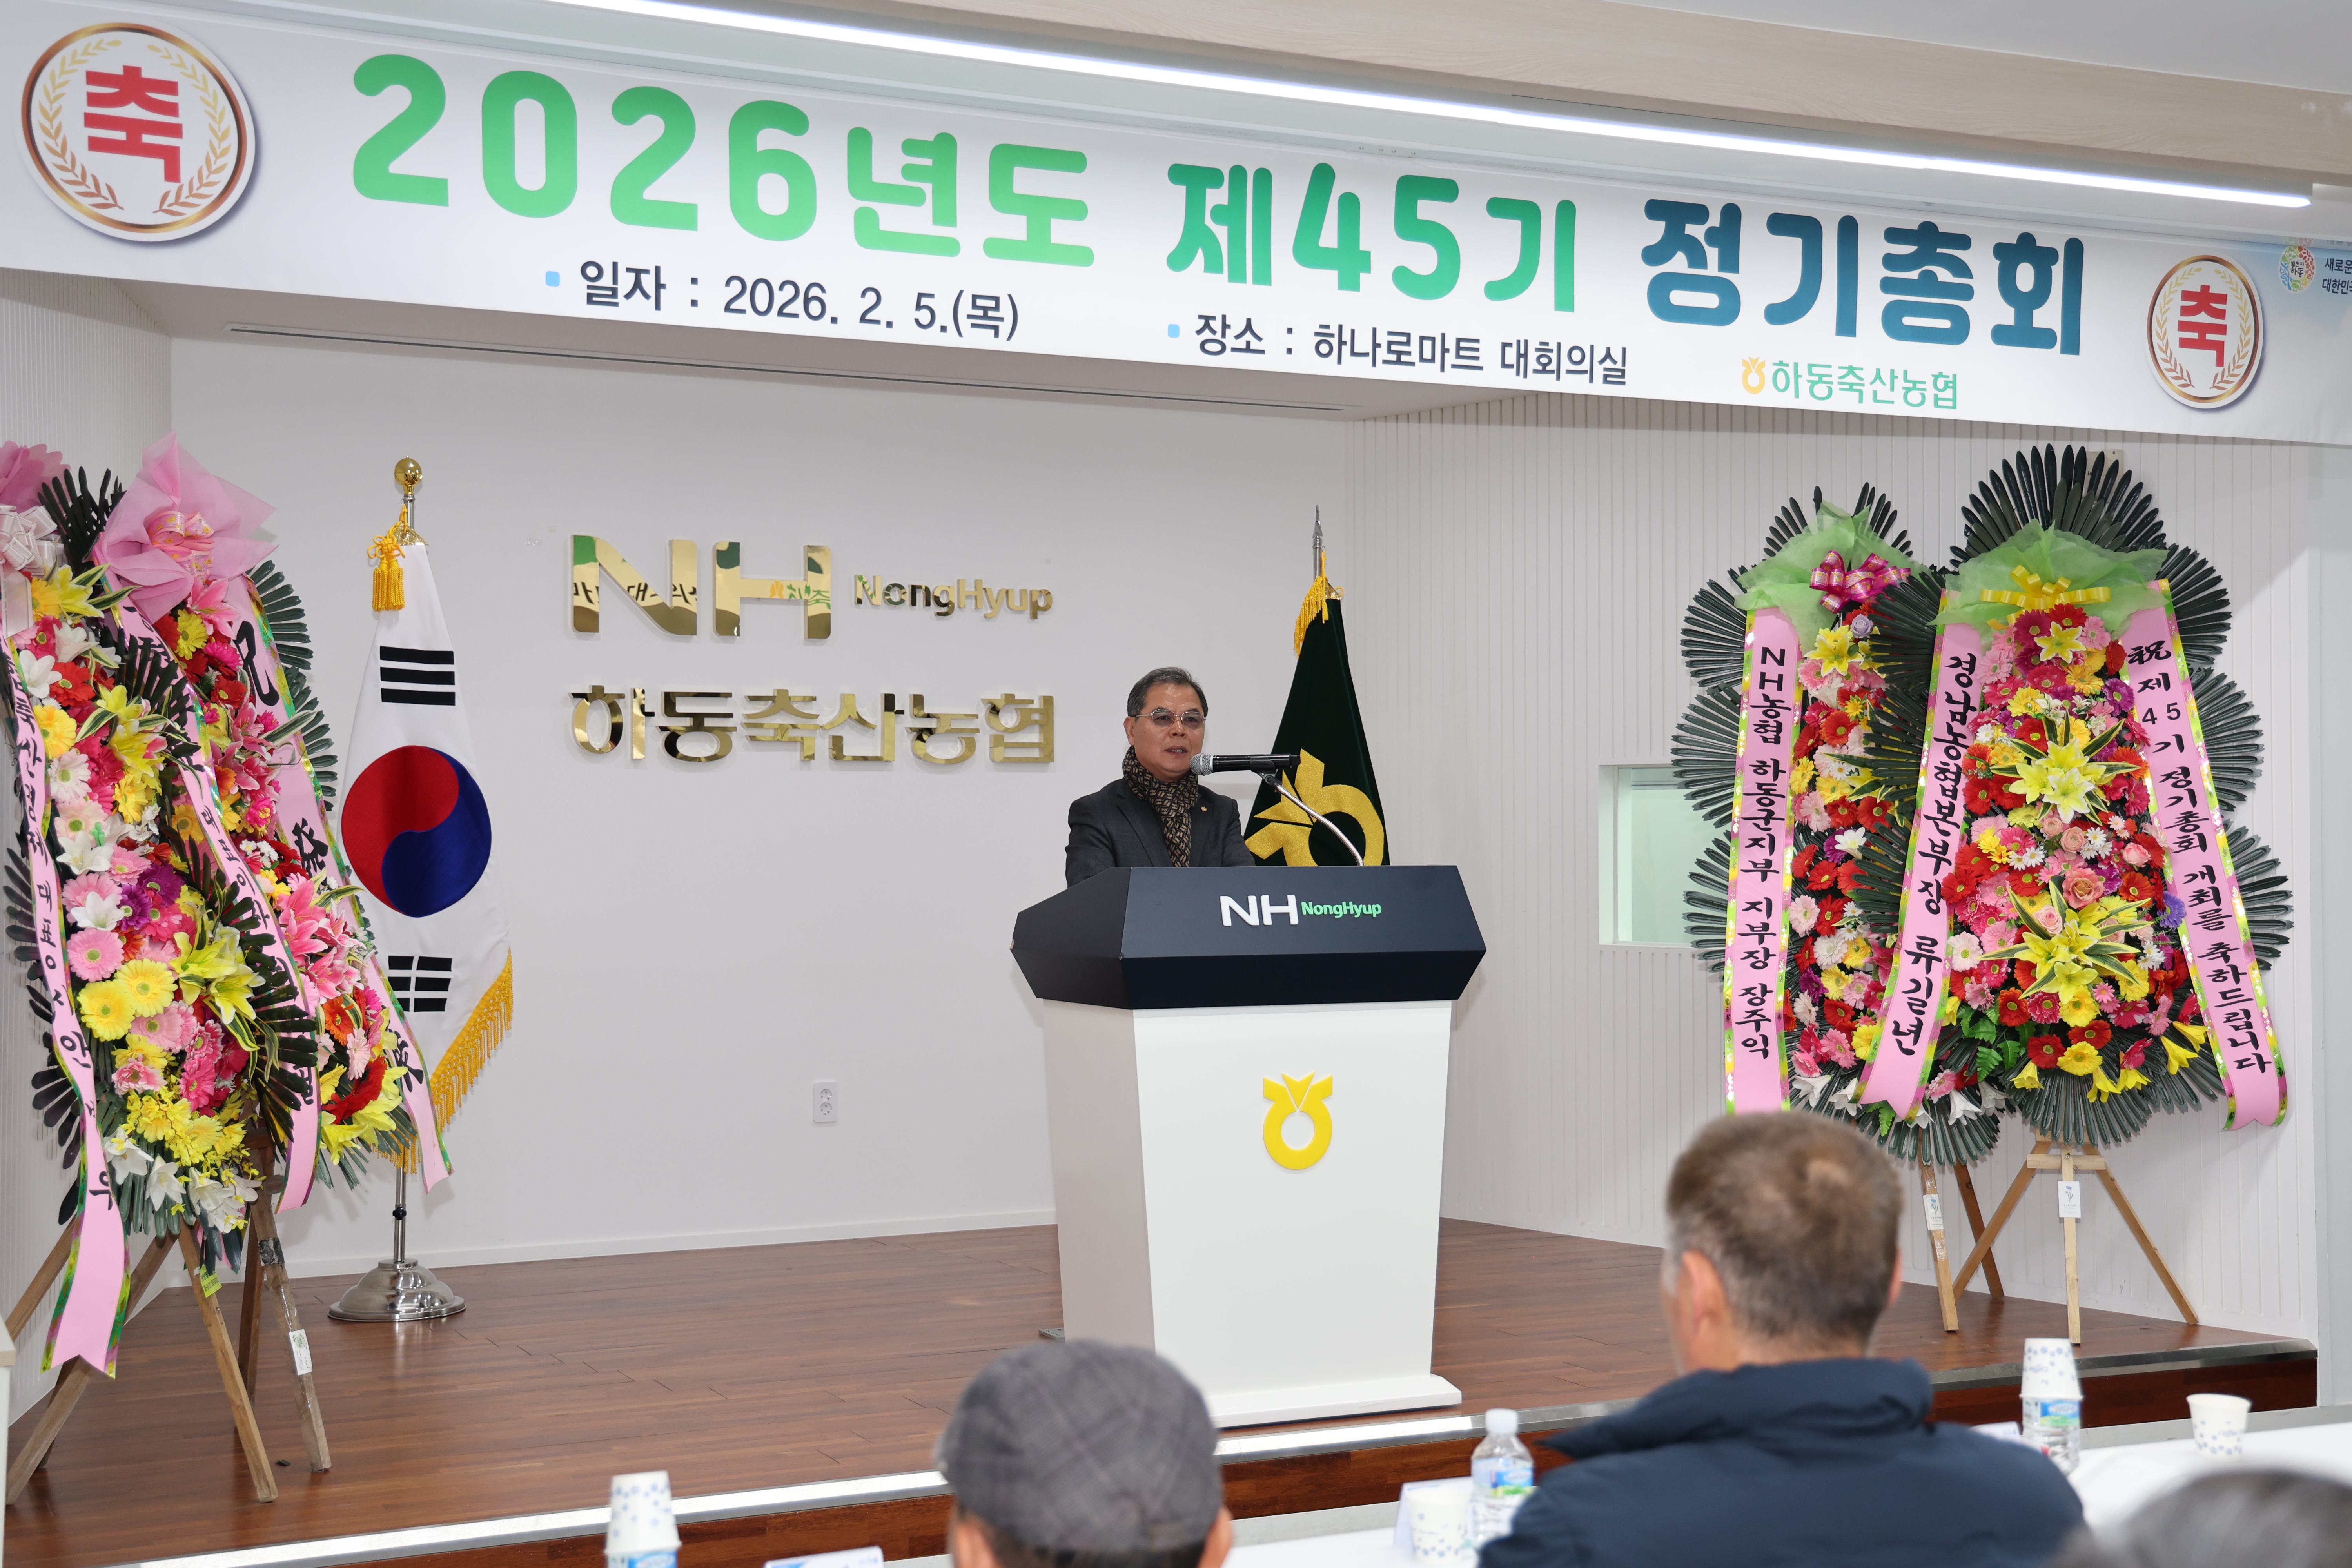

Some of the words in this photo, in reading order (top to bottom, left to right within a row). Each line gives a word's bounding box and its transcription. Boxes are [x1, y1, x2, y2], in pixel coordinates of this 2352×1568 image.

[84, 65, 183, 184] 축
[353, 54, 1094, 267] 2026년도
[1167, 162, 1576, 313] 제45기
[1641, 198, 2084, 356] 정기총회
[580, 261, 666, 310] 일자
[724, 275, 838, 325] 2026.
[859, 287, 893, 328] 2.
[914, 290, 1019, 341] 5.(목)
[2178, 285, 2227, 367] 축
[1195, 314, 1265, 356] 장소
[1314, 324, 1483, 372] 하나로마트
[1501, 339, 1627, 385] 대회의실
[1772, 359, 1958, 409] 하동축산농협
[570, 534, 831, 639] NH
[854, 574, 1053, 620] NongHyup
[2128, 640, 2171, 665] 祝
[568, 685, 1054, 764] 하동축산농협
[1749, 647, 1791, 745] NH농협
[1740, 758, 1786, 882] 하동군지부
[2159, 766, 2209, 854] 정기총회
[1220, 895, 1298, 926] NH
[1301, 901, 1381, 918] NongHyup
[1737, 897, 1776, 970] 지부장
[2182, 864, 2232, 931] 개최를
[1735, 983, 1774, 1059] 장주익
[1892, 936, 1942, 1056] 류길년
[2198, 942, 2272, 1074] 축하드립니다
